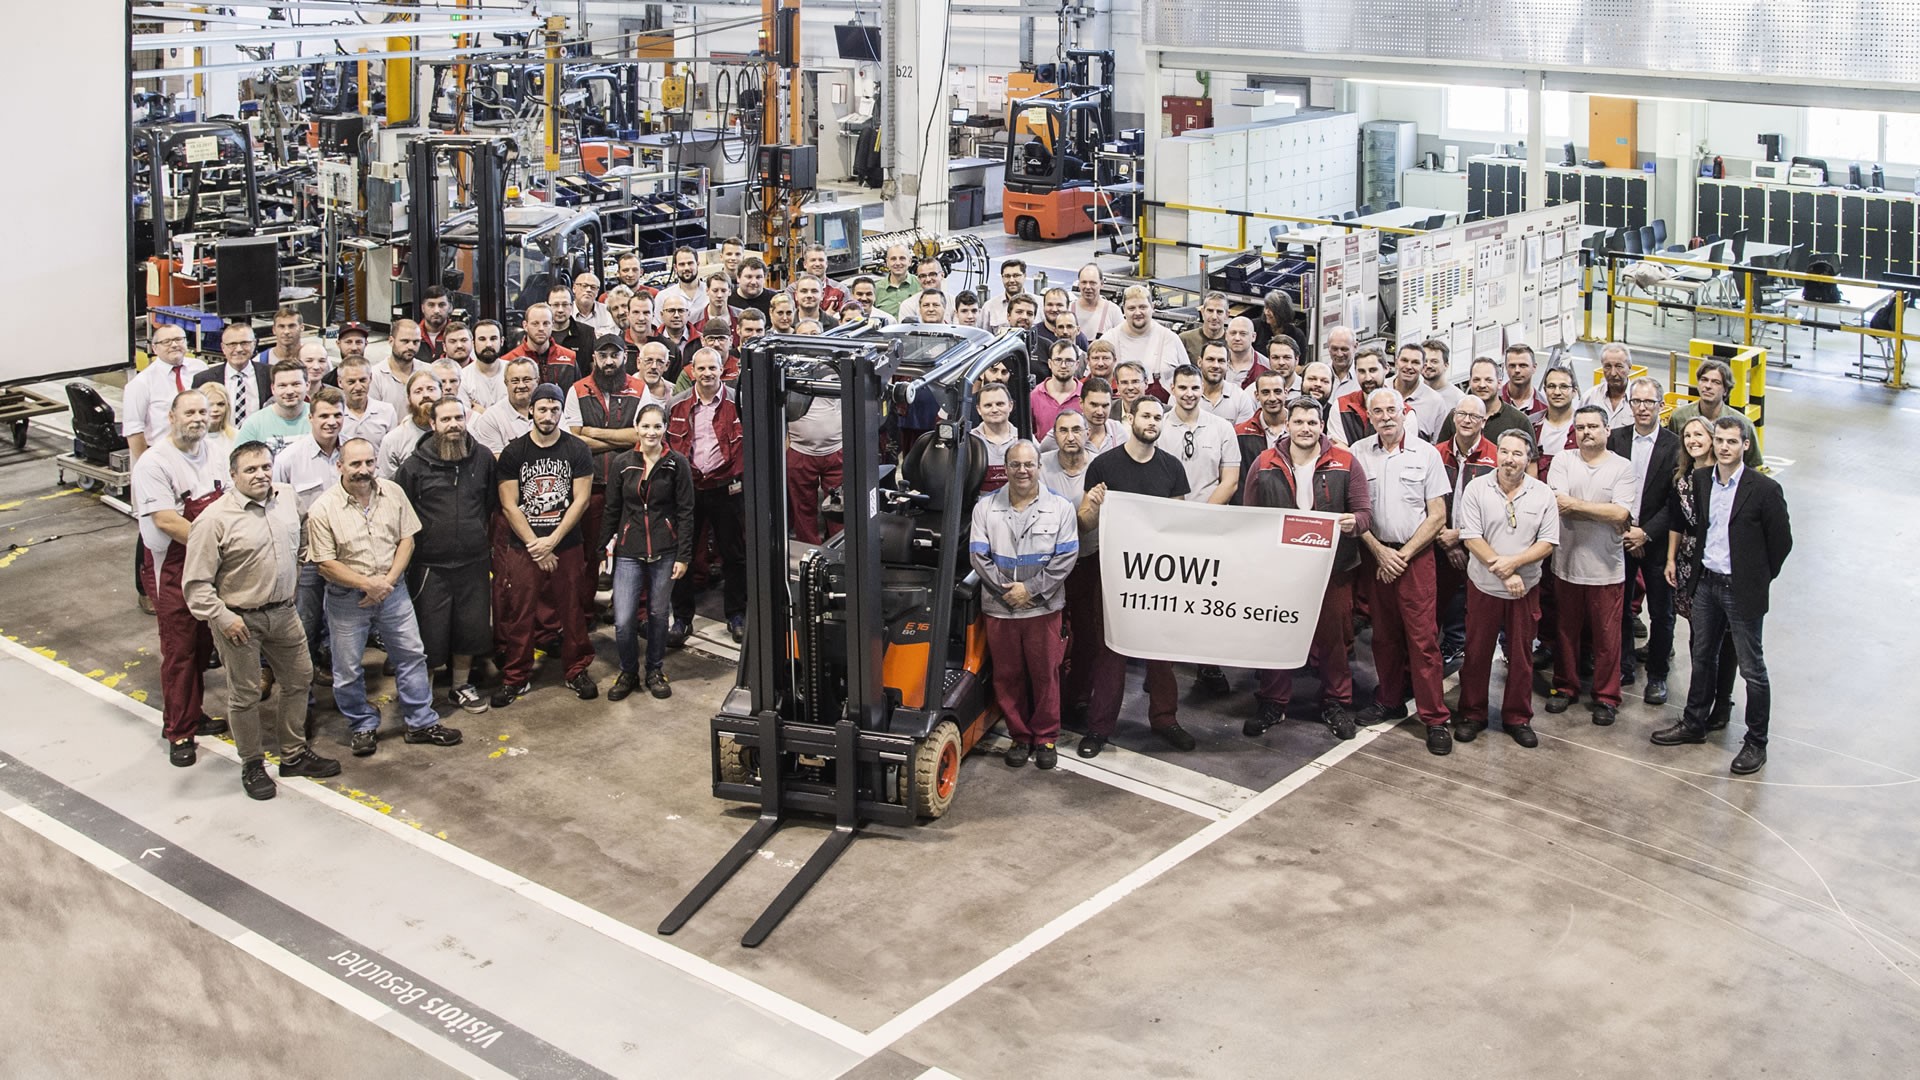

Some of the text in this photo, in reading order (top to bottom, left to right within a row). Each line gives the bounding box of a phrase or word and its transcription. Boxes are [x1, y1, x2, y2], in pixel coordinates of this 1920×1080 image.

[896, 65, 913, 78] b22
[1290, 532, 1330, 546] Linde
[1122, 551, 1221, 587] WOW!
[1119, 592, 1299, 624] 111.111 x 386 series
[917, 622, 930, 631] 16
[327, 949, 504, 1049] Visitors Besucher
